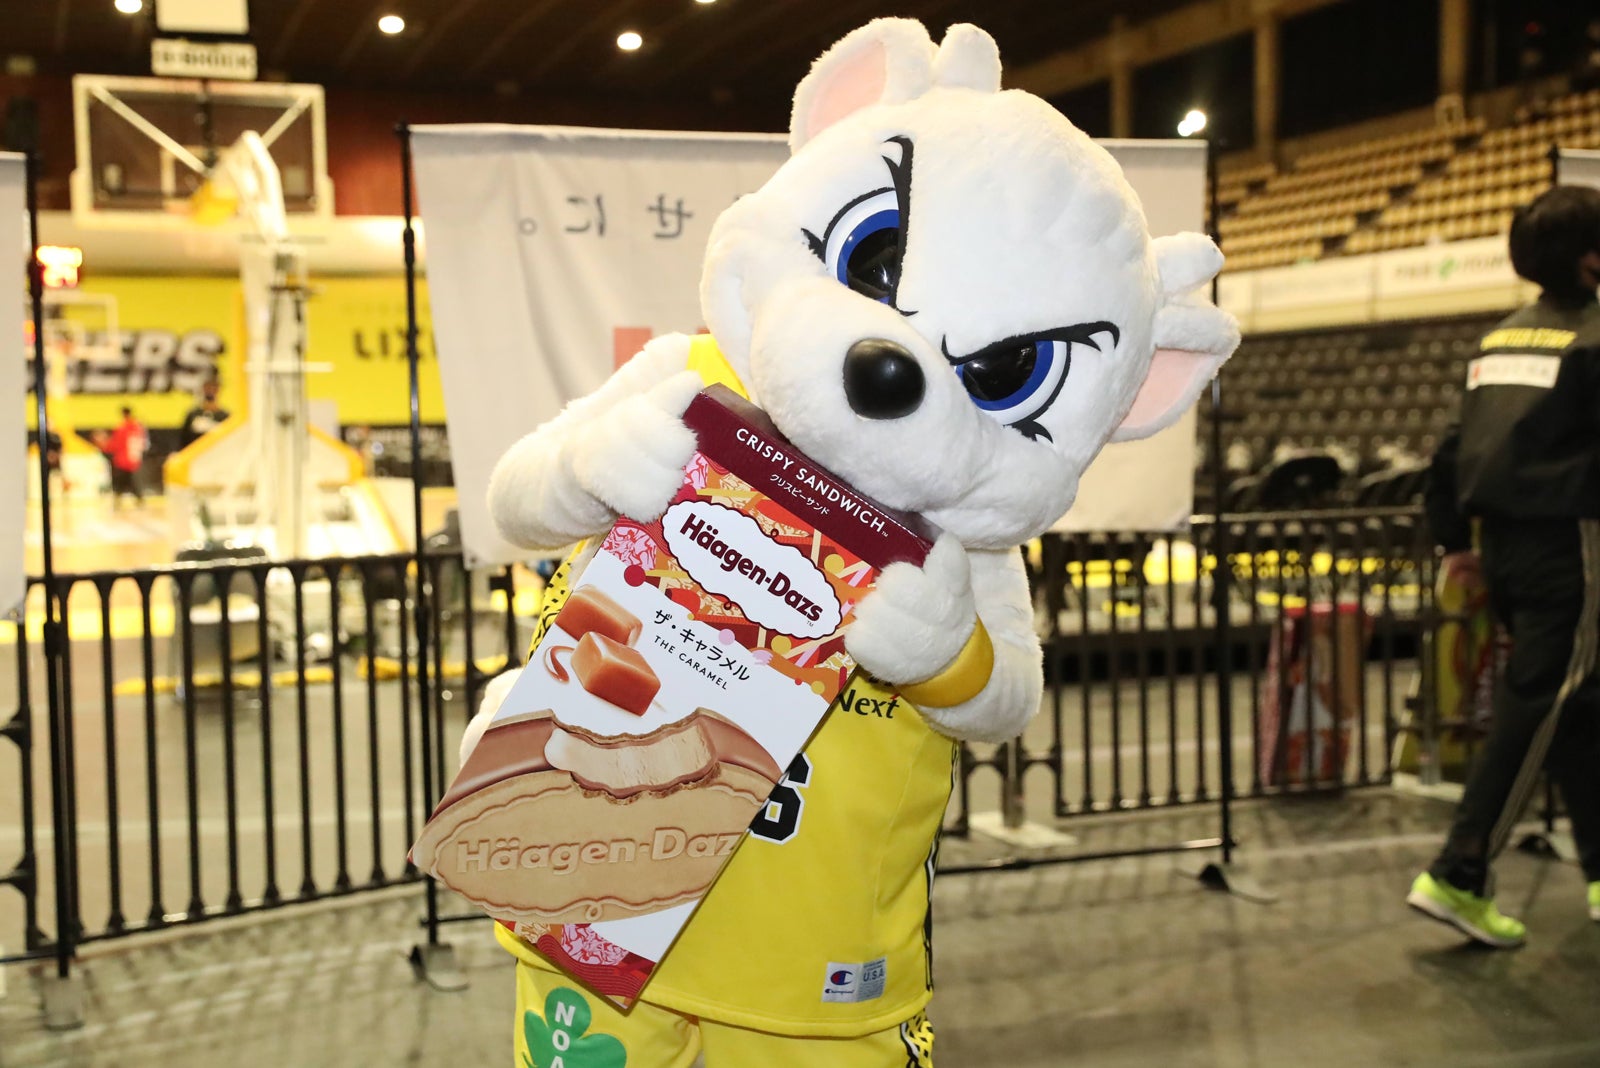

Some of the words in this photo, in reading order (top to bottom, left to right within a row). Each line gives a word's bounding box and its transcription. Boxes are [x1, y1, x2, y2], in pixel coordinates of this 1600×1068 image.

[736, 428, 794, 470] CRISPY
[796, 468, 886, 533] SANDWICH
[770, 473, 830, 516] クリスピーサンド
[680, 513, 823, 622] Häagen-Dazs
[654, 609, 750, 682] ザ・キャラメル
[654, 635, 676, 654] THE
[678, 652, 728, 690] CARAMEL
[838, 689, 900, 719] Next
